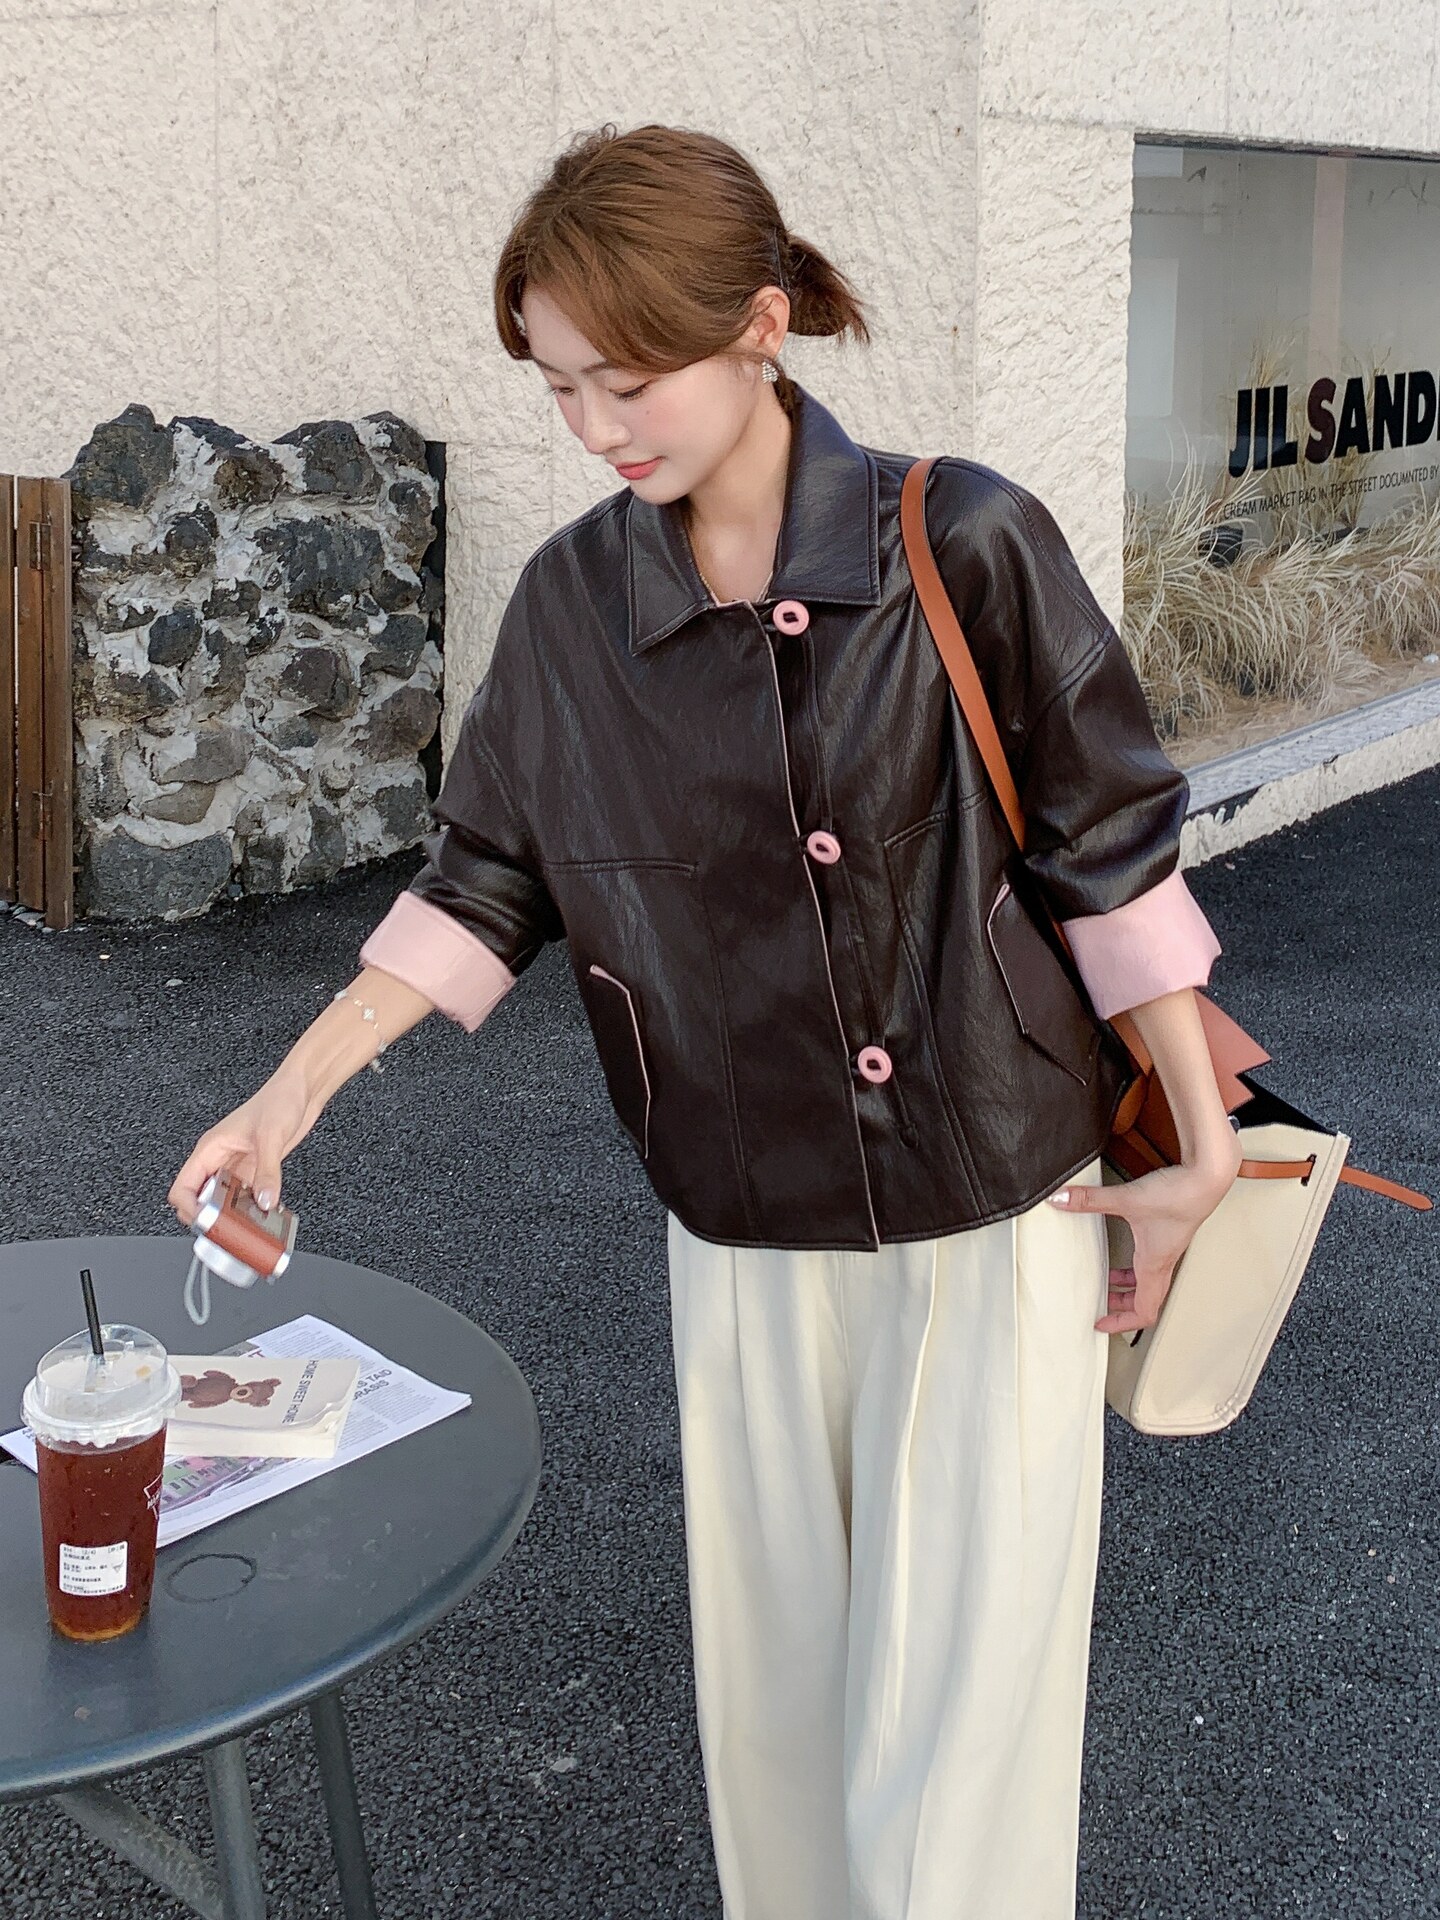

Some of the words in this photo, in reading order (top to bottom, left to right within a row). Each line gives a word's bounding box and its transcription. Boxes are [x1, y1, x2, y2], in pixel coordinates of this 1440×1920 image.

[1228, 385, 1298, 478] JIL
[1305, 370, 1440, 464] SAND
[1224, 500, 1257, 519] CREAM
[1259, 491, 1296, 512] MARKET
[1298, 487, 1316, 505] BAG
[1331, 482, 1348, 498] THE
[1348, 475, 1377, 496] STREET
